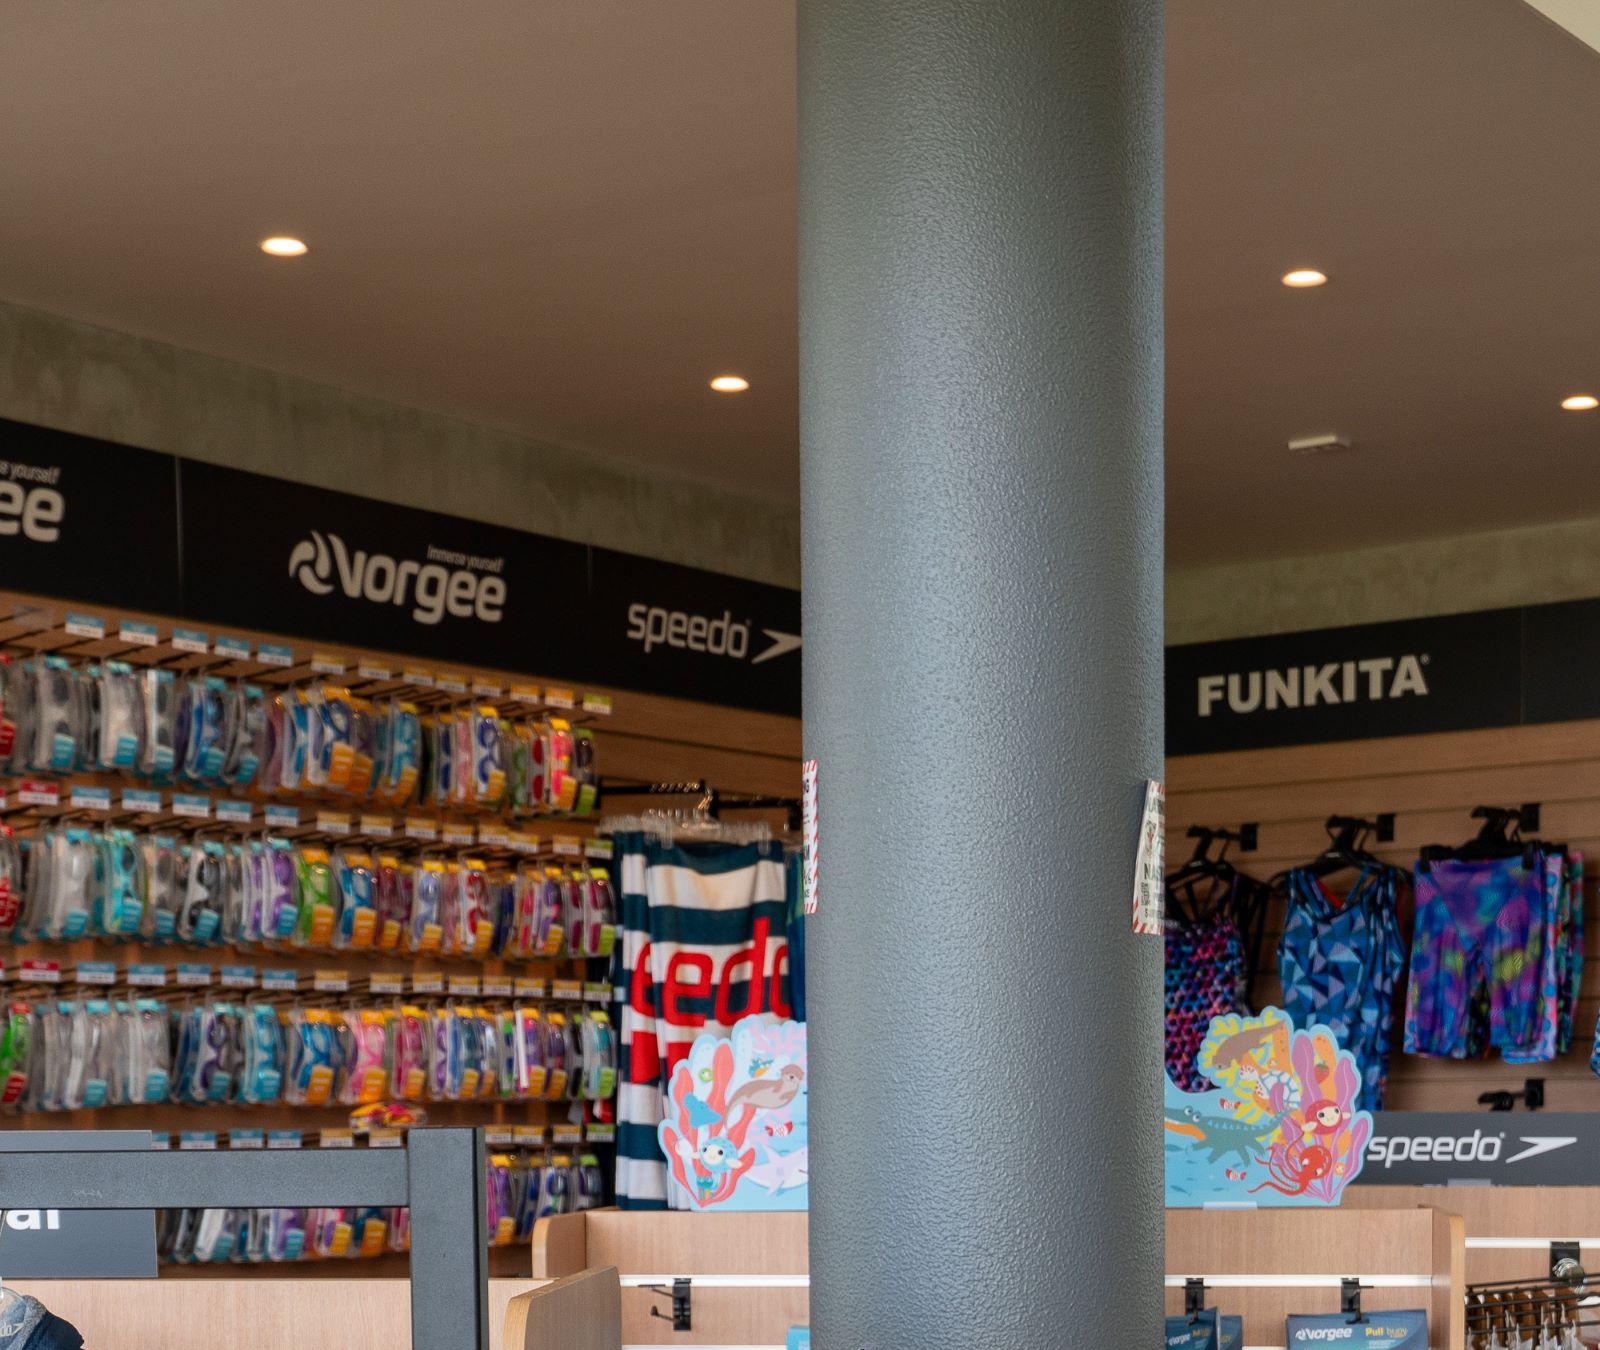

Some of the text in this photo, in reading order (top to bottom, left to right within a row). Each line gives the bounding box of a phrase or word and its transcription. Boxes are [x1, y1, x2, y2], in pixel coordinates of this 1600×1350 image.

[626, 602, 749, 659] speedo
[1197, 656, 1430, 717] FUNKITA
[1367, 1129, 1501, 1168] speedo
[1365, 1327, 1384, 1337] Pull
